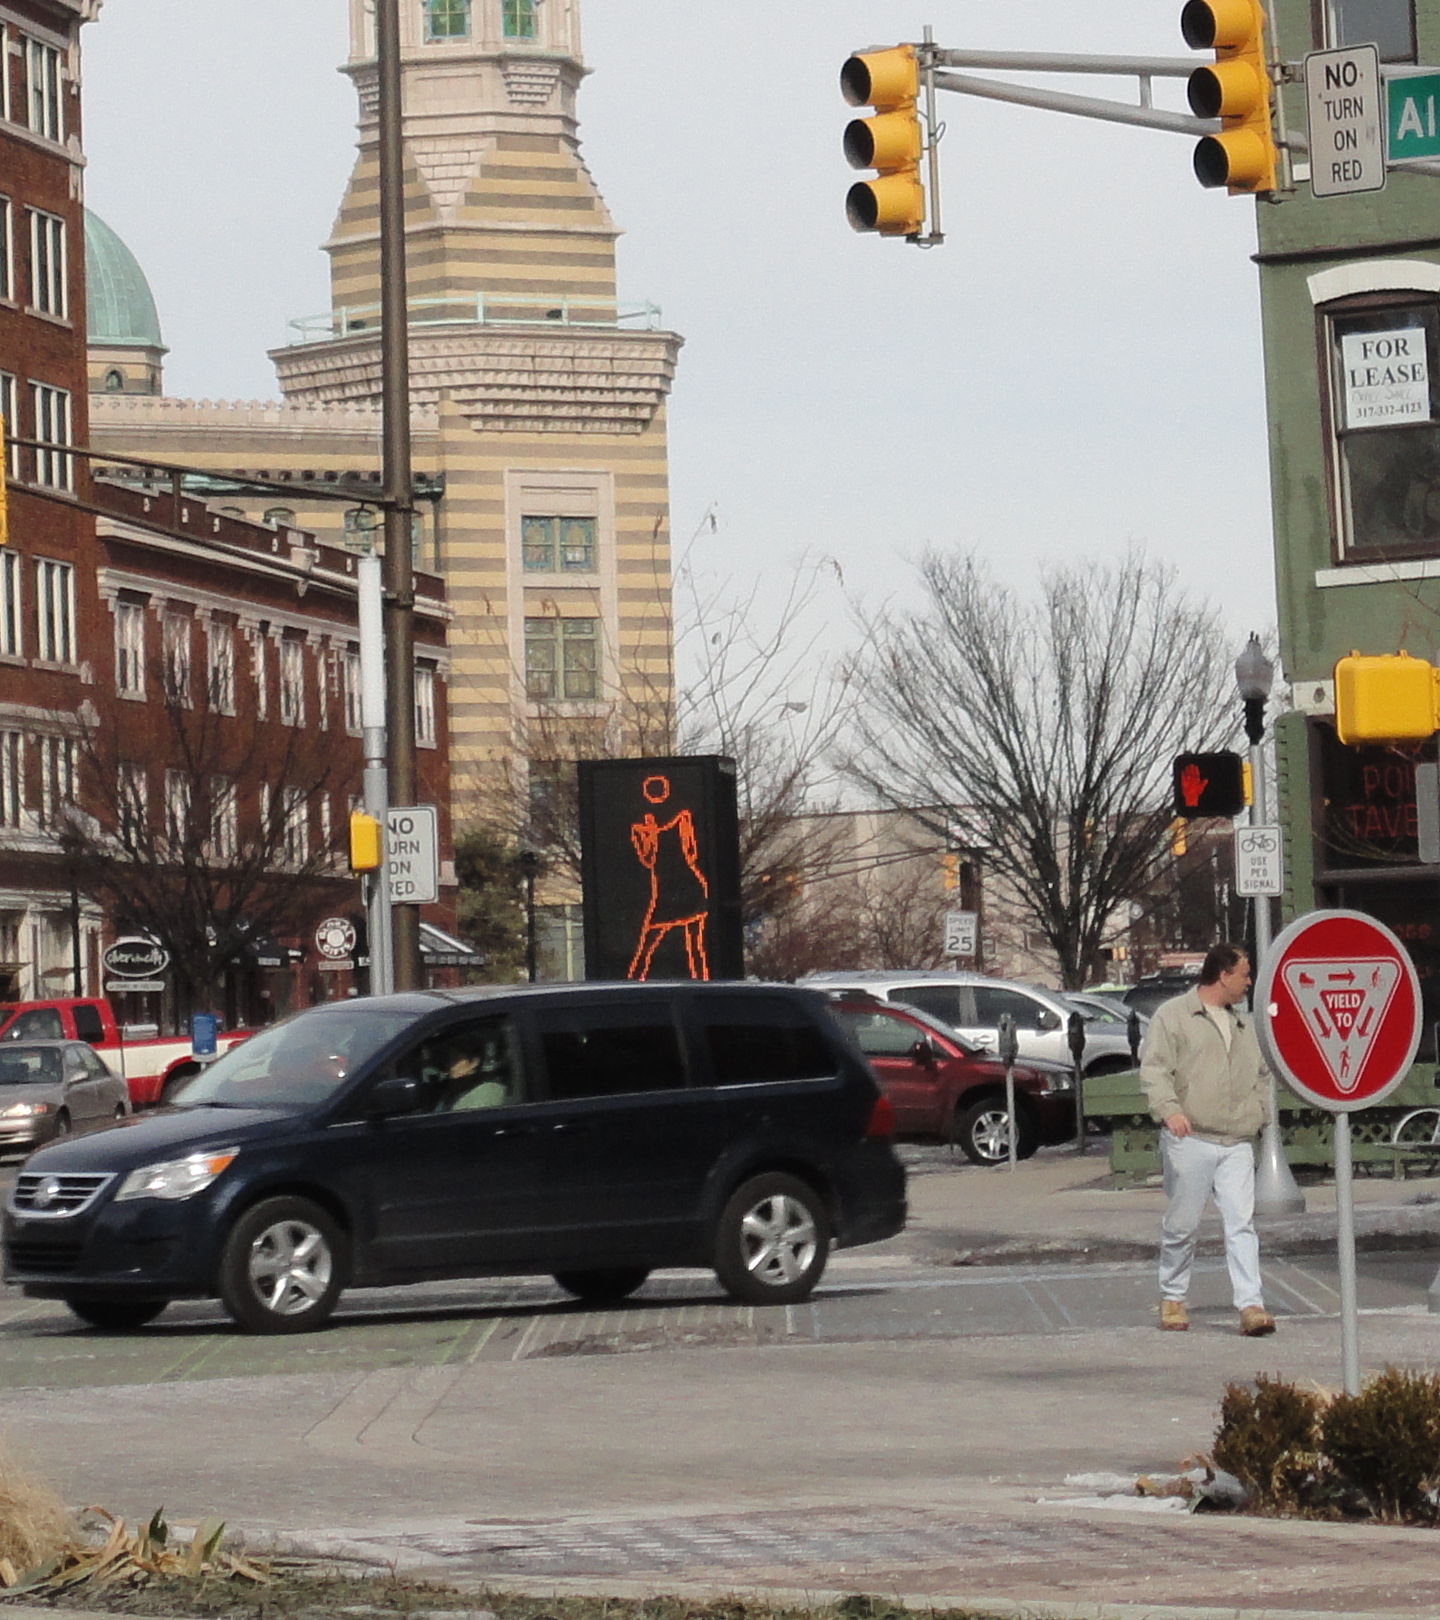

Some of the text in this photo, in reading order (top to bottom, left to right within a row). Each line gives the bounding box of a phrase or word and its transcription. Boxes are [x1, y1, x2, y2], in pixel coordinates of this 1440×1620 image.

[1325, 61, 1358, 90] NO
[1324, 96, 1364, 122] TURN
[1334, 128, 1358, 152] ON
[1331, 159, 1363, 184] RED
[1361, 337, 1411, 361] FOR
[1350, 362, 1426, 389] LEASE
[1363, 764, 1417, 799] POI
[387, 817, 414, 835] NO
[1343, 803, 1419, 838] TAVE
[388, 840, 421, 855] URN
[389, 860, 412, 875] ON
[1250, 856, 1268, 866] USE
[1244, 879, 1277, 890] SIGNAL
[948, 935, 973, 952] 25
[1325, 993, 1361, 1009] YIELD
[1335, 1012, 1353, 1028] TO
